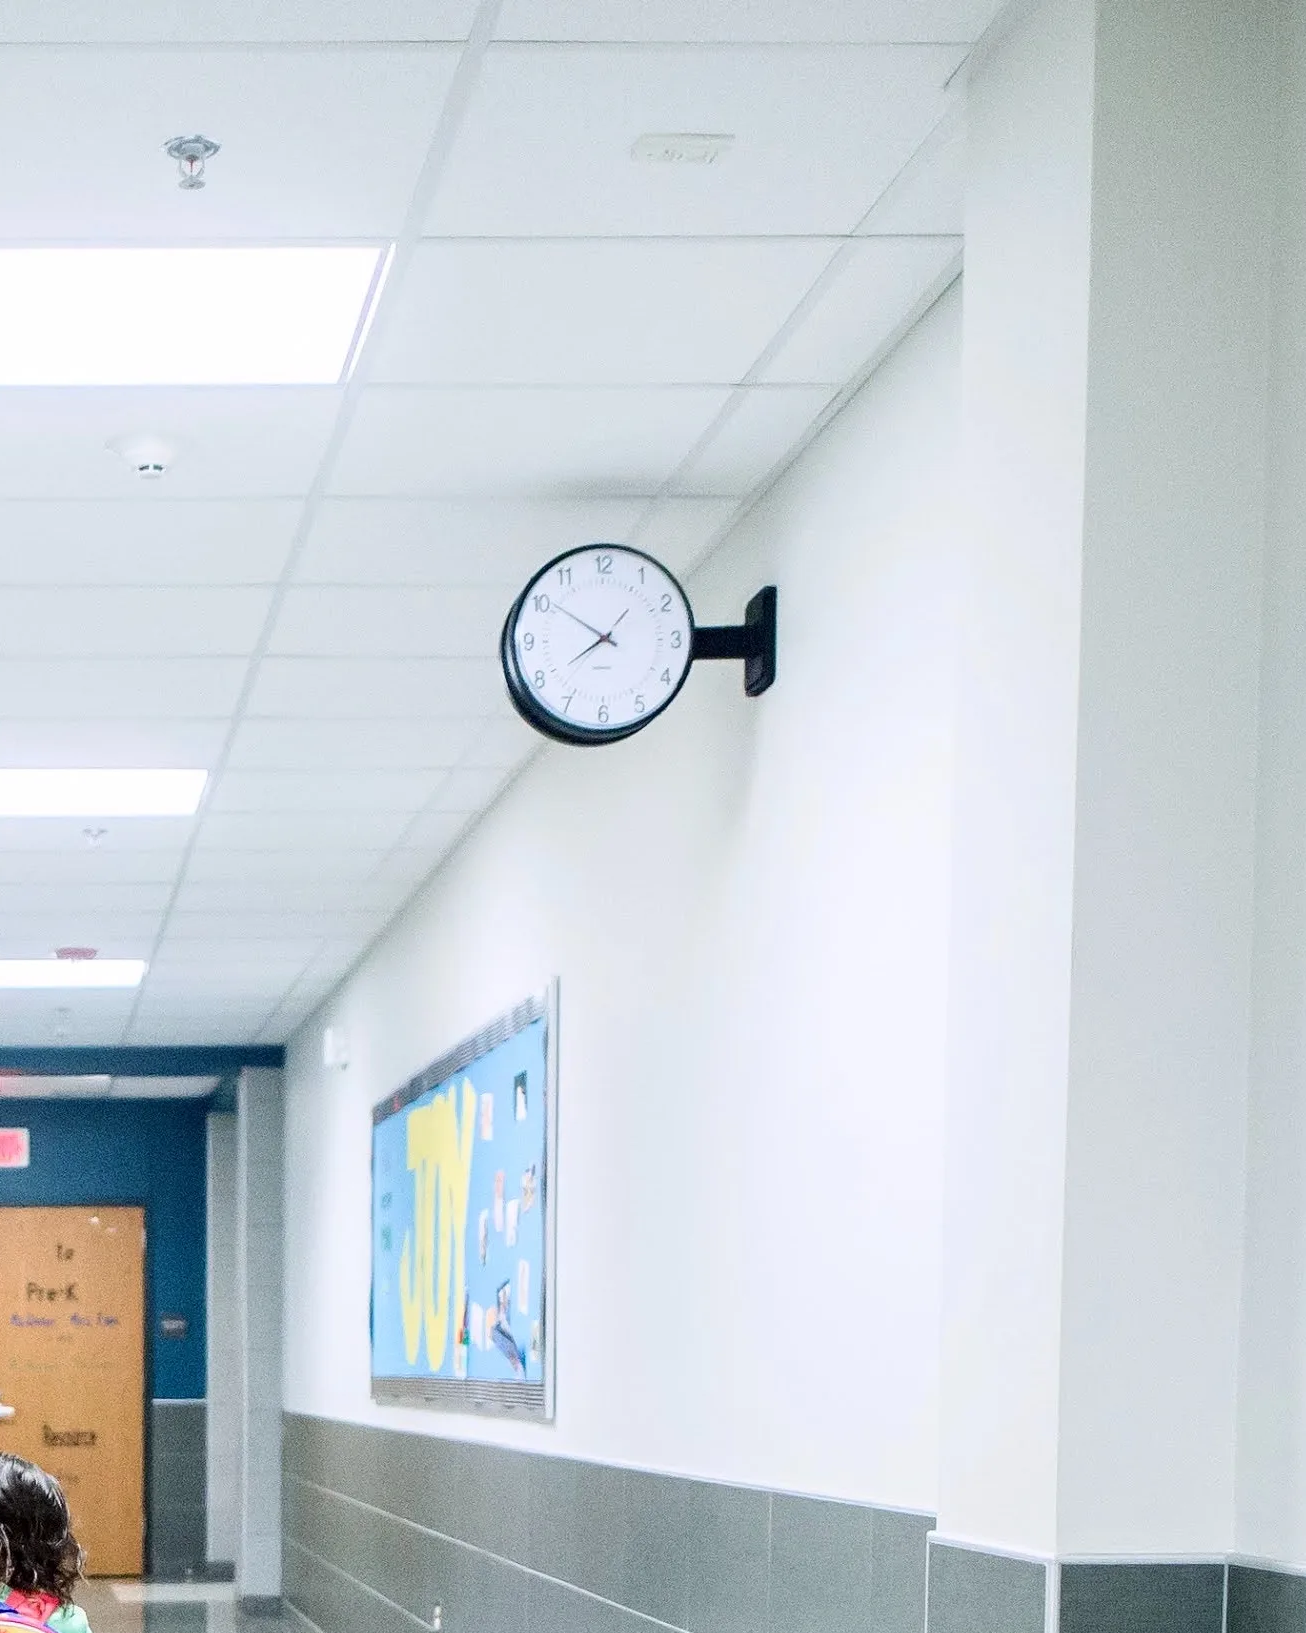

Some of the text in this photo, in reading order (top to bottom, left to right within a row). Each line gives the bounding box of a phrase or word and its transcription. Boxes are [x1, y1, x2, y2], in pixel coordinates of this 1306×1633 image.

[594, 556, 613, 574] 12
[557, 567, 572, 585] 11
[637, 567, 646, 584] 1
[534, 594, 550, 612] 10
[661, 594, 672, 612] 2
[523, 632, 535, 651] 9
[670, 630, 682, 648] 3
[535, 670, 546, 688] 8
[660, 667, 671, 685] 4
[561, 695, 574, 713] 7
[634, 695, 645, 712] 5
[598, 705, 609, 723] 6
